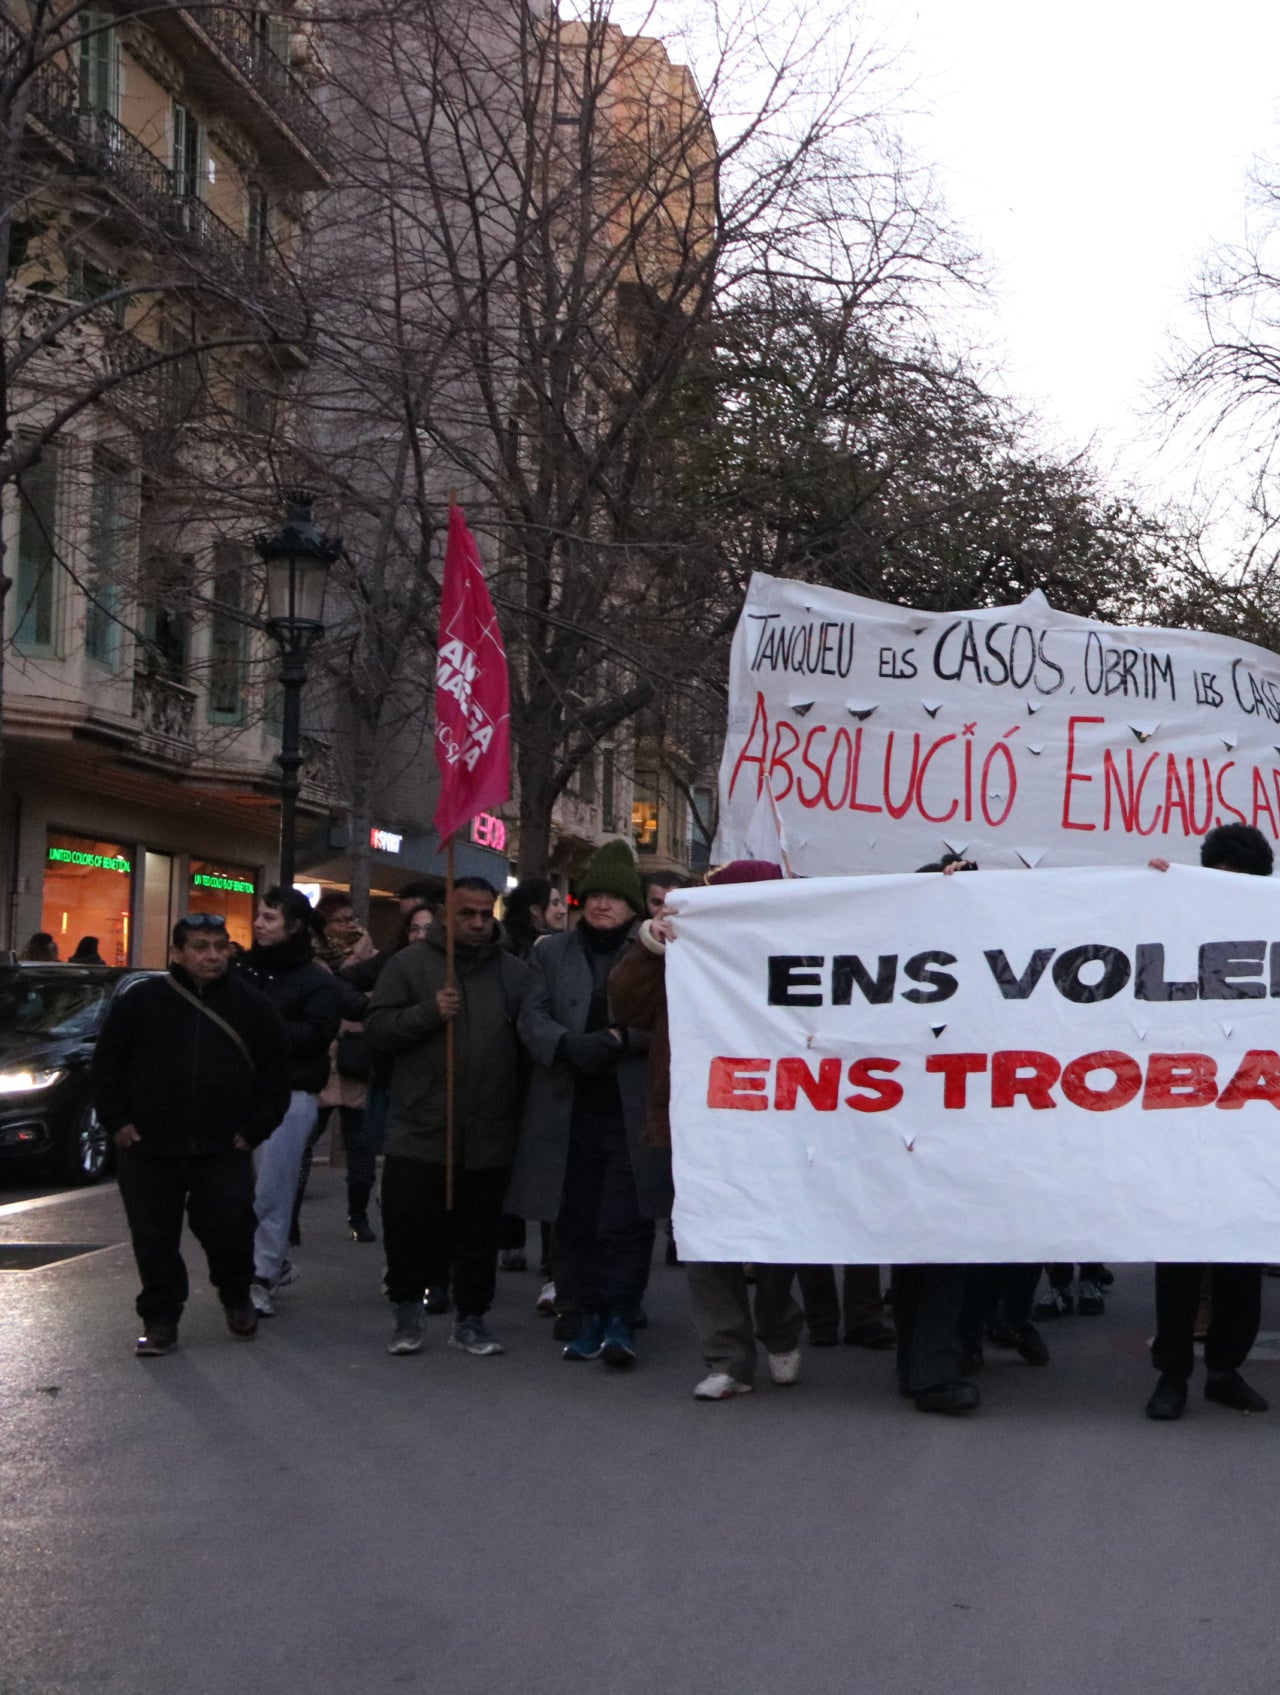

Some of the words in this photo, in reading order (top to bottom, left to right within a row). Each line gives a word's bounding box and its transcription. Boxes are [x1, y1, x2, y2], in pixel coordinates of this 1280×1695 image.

[748, 613, 855, 679] TANQUEU
[878, 647, 918, 680] ELS
[1084, 631, 1176, 701] OBRIM
[1193, 670, 1224, 709] LES
[729, 691, 1019, 827] ABSOLUCIÓ
[49, 848, 71, 862] UNITED
[72, 851, 94, 867] COLORS
[94, 855, 102, 867] OF
[194, 874, 210, 886] UNTED
[767, 950, 958, 1007] ENS
[707, 1055, 904, 1112] ENS
